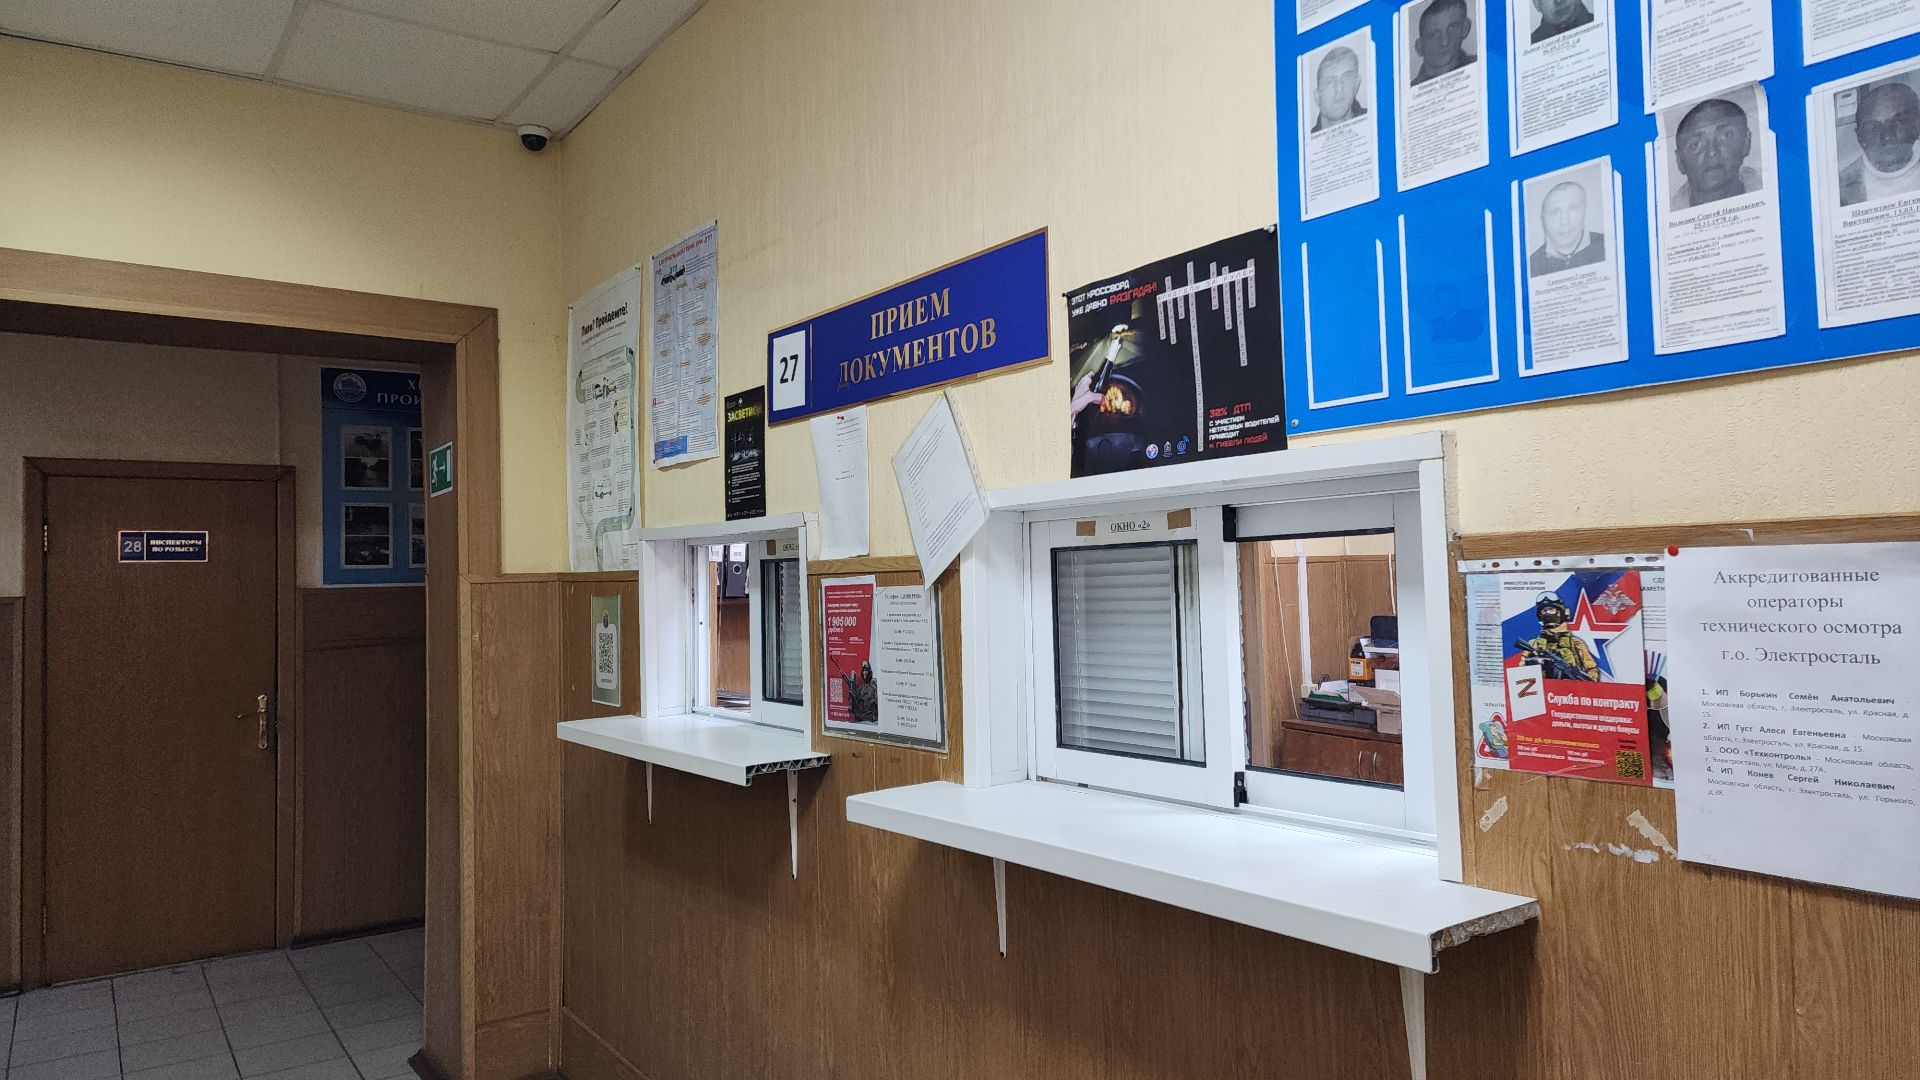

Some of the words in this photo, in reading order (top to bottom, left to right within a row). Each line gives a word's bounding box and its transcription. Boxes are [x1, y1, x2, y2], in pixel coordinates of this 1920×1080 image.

[1071, 293, 1086, 306] ЭТОТ
[1086, 279, 1130, 299] КРОССВОРД
[1071, 306, 1084, 318] УЖЕ
[1084, 298, 1108, 313] ДАВНО
[1109, 281, 1158, 305] РАЗГАДАН!
[869, 287, 951, 340] ПРИЕМ
[837, 317, 997, 391] ДОКУМЕНТОВ
[779, 354, 799, 384] 27
[1233, 402, 1252, 415] ДТП
[1209, 424, 1244, 434] НЕТРЕЗВЫХ
[1244, 414, 1280, 429] ВОДИТЕЛЕЙ
[1214, 415, 1246, 426] УЧАСТИЕМ
[1209, 430, 1240, 441] ПРИВОДИТ
[1215, 438, 1244, 449] ГИБЕЛИ
[1243, 432, 1268, 444] ЛЮДЕЙ
[1110, 521, 1136, 532] ОКНО
[123, 541, 142, 553] 28
[1714, 570, 1881, 588] Аккредитованные
[1746, 596, 1844, 612] операторы
[1700, 621, 1818, 634] технического
[1823, 622, 1904, 638] осмотра
[1721, 649, 1750, 662] г.о.
[1754, 648, 1881, 666] Электросталь
[1515, 678, 1541, 699] Z
[1715, 689, 1729, 697] ИП
[1739, 690, 1778, 699] Борькин
[1788, 692, 1819, 701] Семён
[1830, 694, 1895, 705] Анатольевич
[1547, 692, 1580, 708] Служба
[1580, 697, 1592, 707] по
[1593, 697, 1640, 713] контракту
[1701, 701, 1744, 709] Московская
[1717, 723, 1730, 731] ИП
[1735, 724, 1753, 734] Густ
[1759, 726, 1786, 735] Алеся
[1792, 728, 1847, 739] Евгеньевна
[1862, 734, 1912, 743] Московская
[1719, 746, 1740, 755] ООО
[1744, 749, 1812, 761] «Техконтроль»
[1824, 756, 1873, 767] Московская
[1707, 778, 1750, 788] Московская
[1720, 767, 1733, 775] ИП
[1747, 769, 1774, 779] Конев
[1787, 773, 1819, 784] Сергей
[1834, 778, 1896, 790] Николаевич
